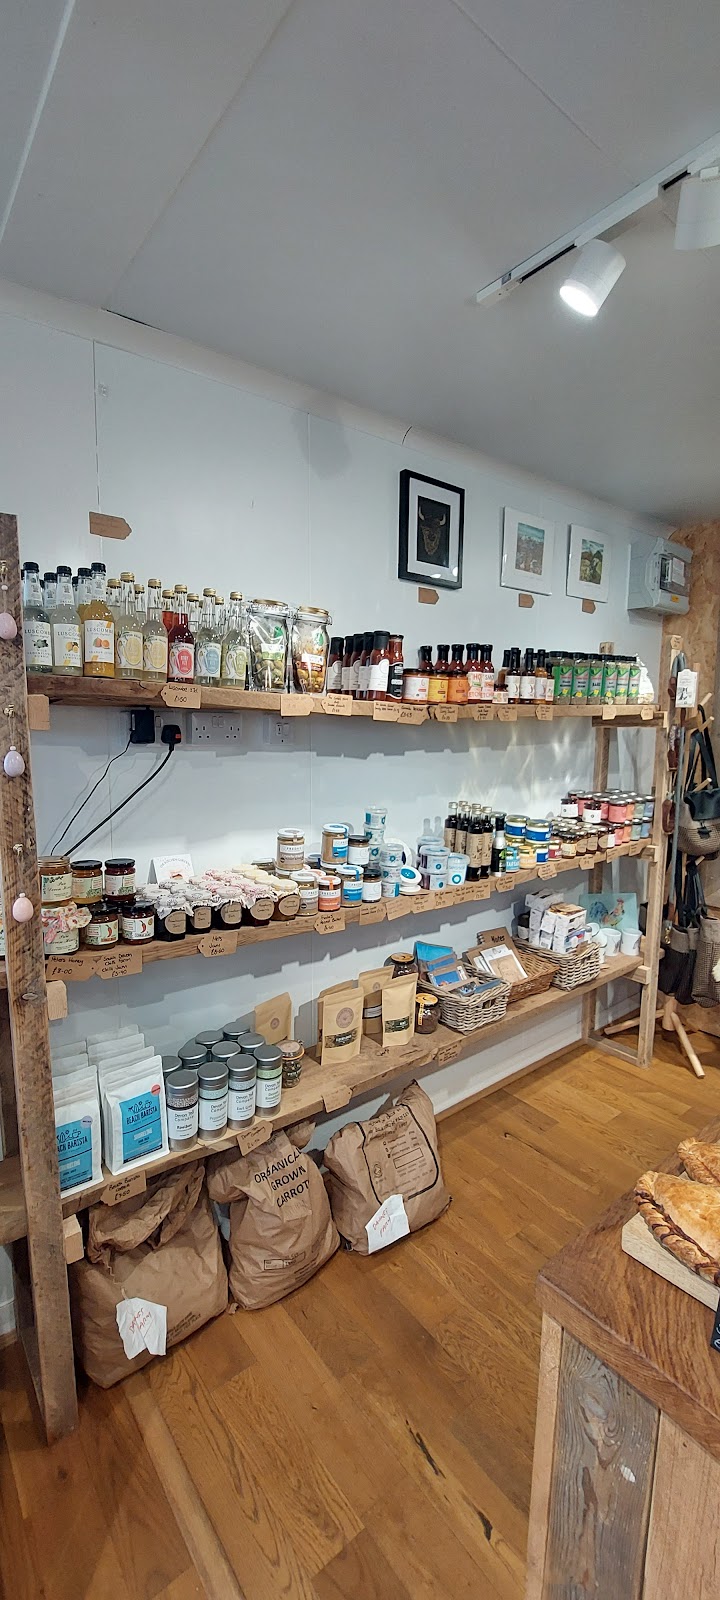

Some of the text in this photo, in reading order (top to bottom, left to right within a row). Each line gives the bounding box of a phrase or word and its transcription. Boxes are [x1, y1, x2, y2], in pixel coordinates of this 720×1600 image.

[490, 935, 506, 944] Notes
[126, 1105, 158, 1125] BEACH BARISTA
[67, 1136, 88, 1150] BARISTA
[254, 1147, 303, 1184] ORGANICAL
[270, 1165, 307, 1191] GROWN
[276, 1179, 310, 1208] CARROT
